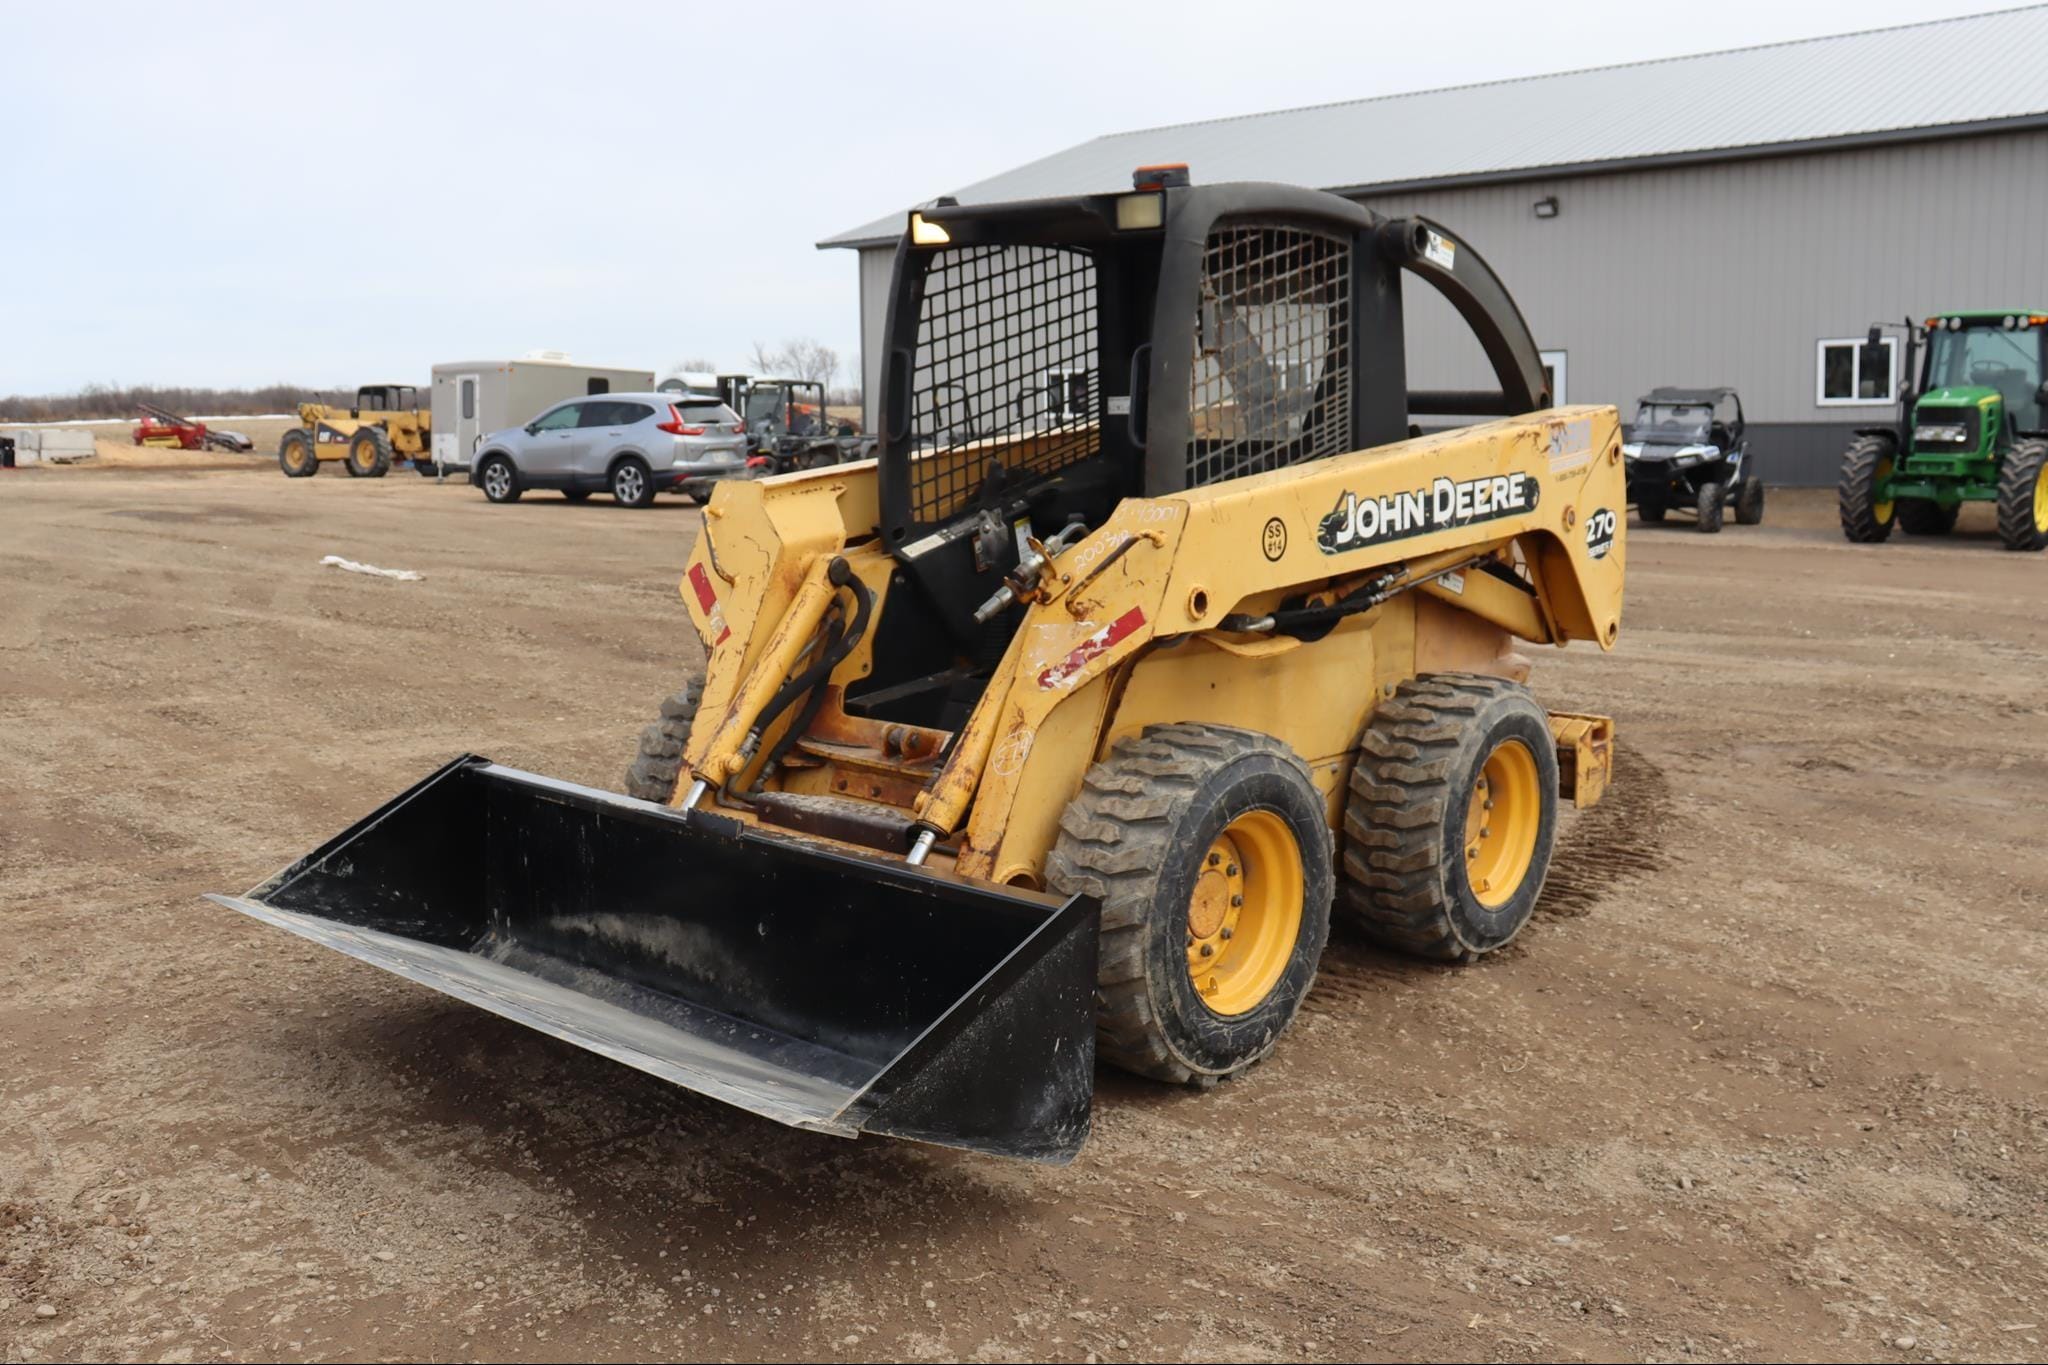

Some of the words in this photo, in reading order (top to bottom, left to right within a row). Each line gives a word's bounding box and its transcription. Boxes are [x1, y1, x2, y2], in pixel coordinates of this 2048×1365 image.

[1336, 491, 1425, 544] JOHN
[1433, 473, 1526, 523] DEERE
[1267, 524, 1281, 539] SS
[1585, 511, 1616, 542] 270
